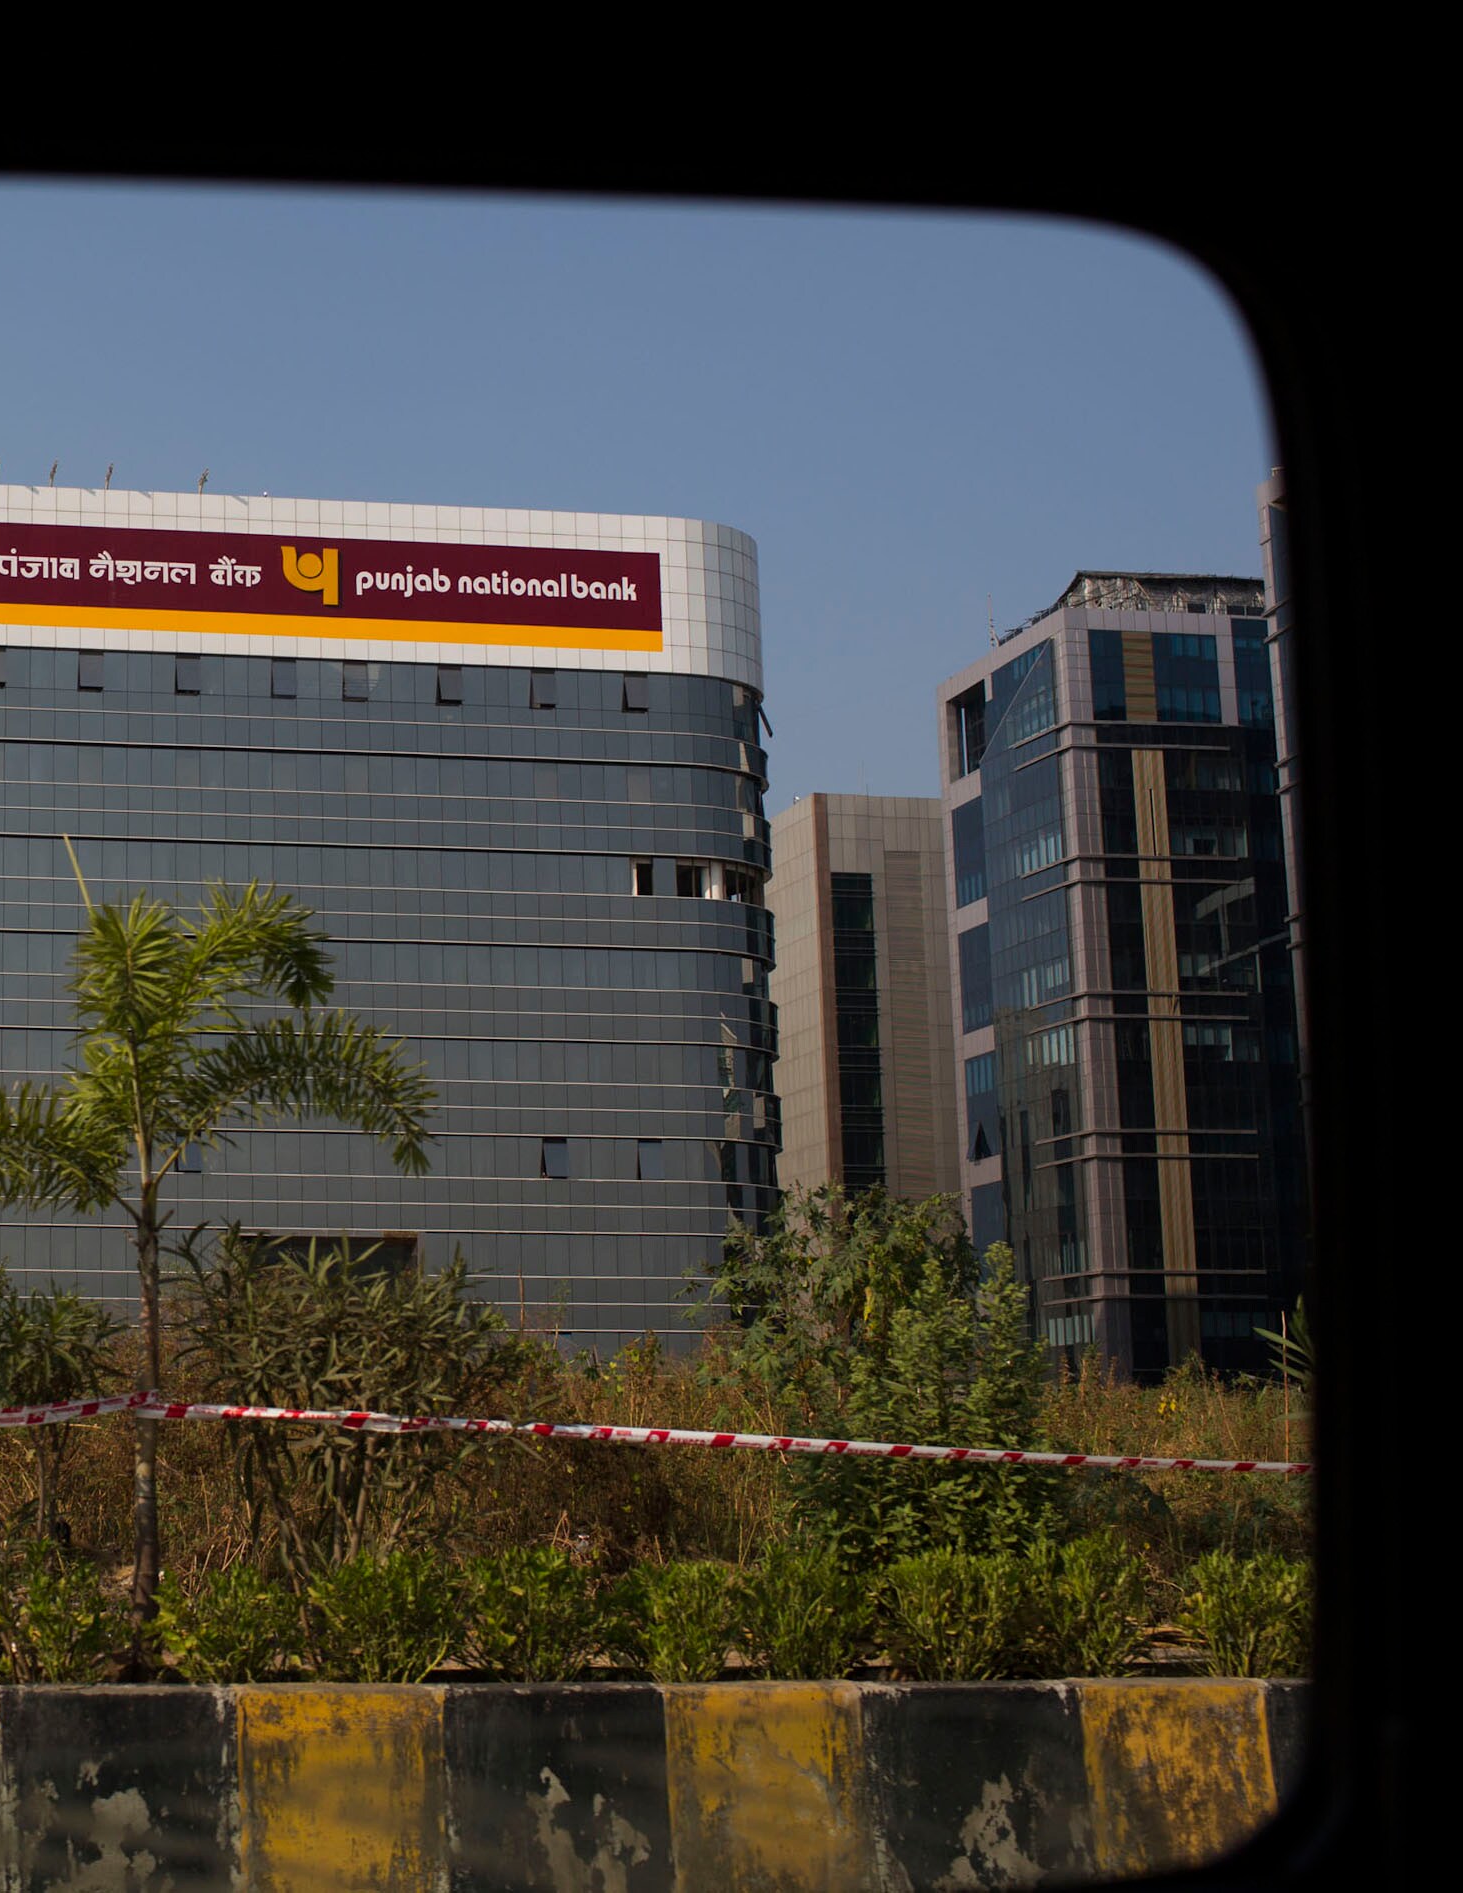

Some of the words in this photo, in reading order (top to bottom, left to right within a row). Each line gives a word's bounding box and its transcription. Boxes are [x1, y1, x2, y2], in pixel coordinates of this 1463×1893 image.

[88, 550, 196, 585] नैशनल
[208, 555, 262, 588] बैंक
[354, 565, 451, 598] punjab
